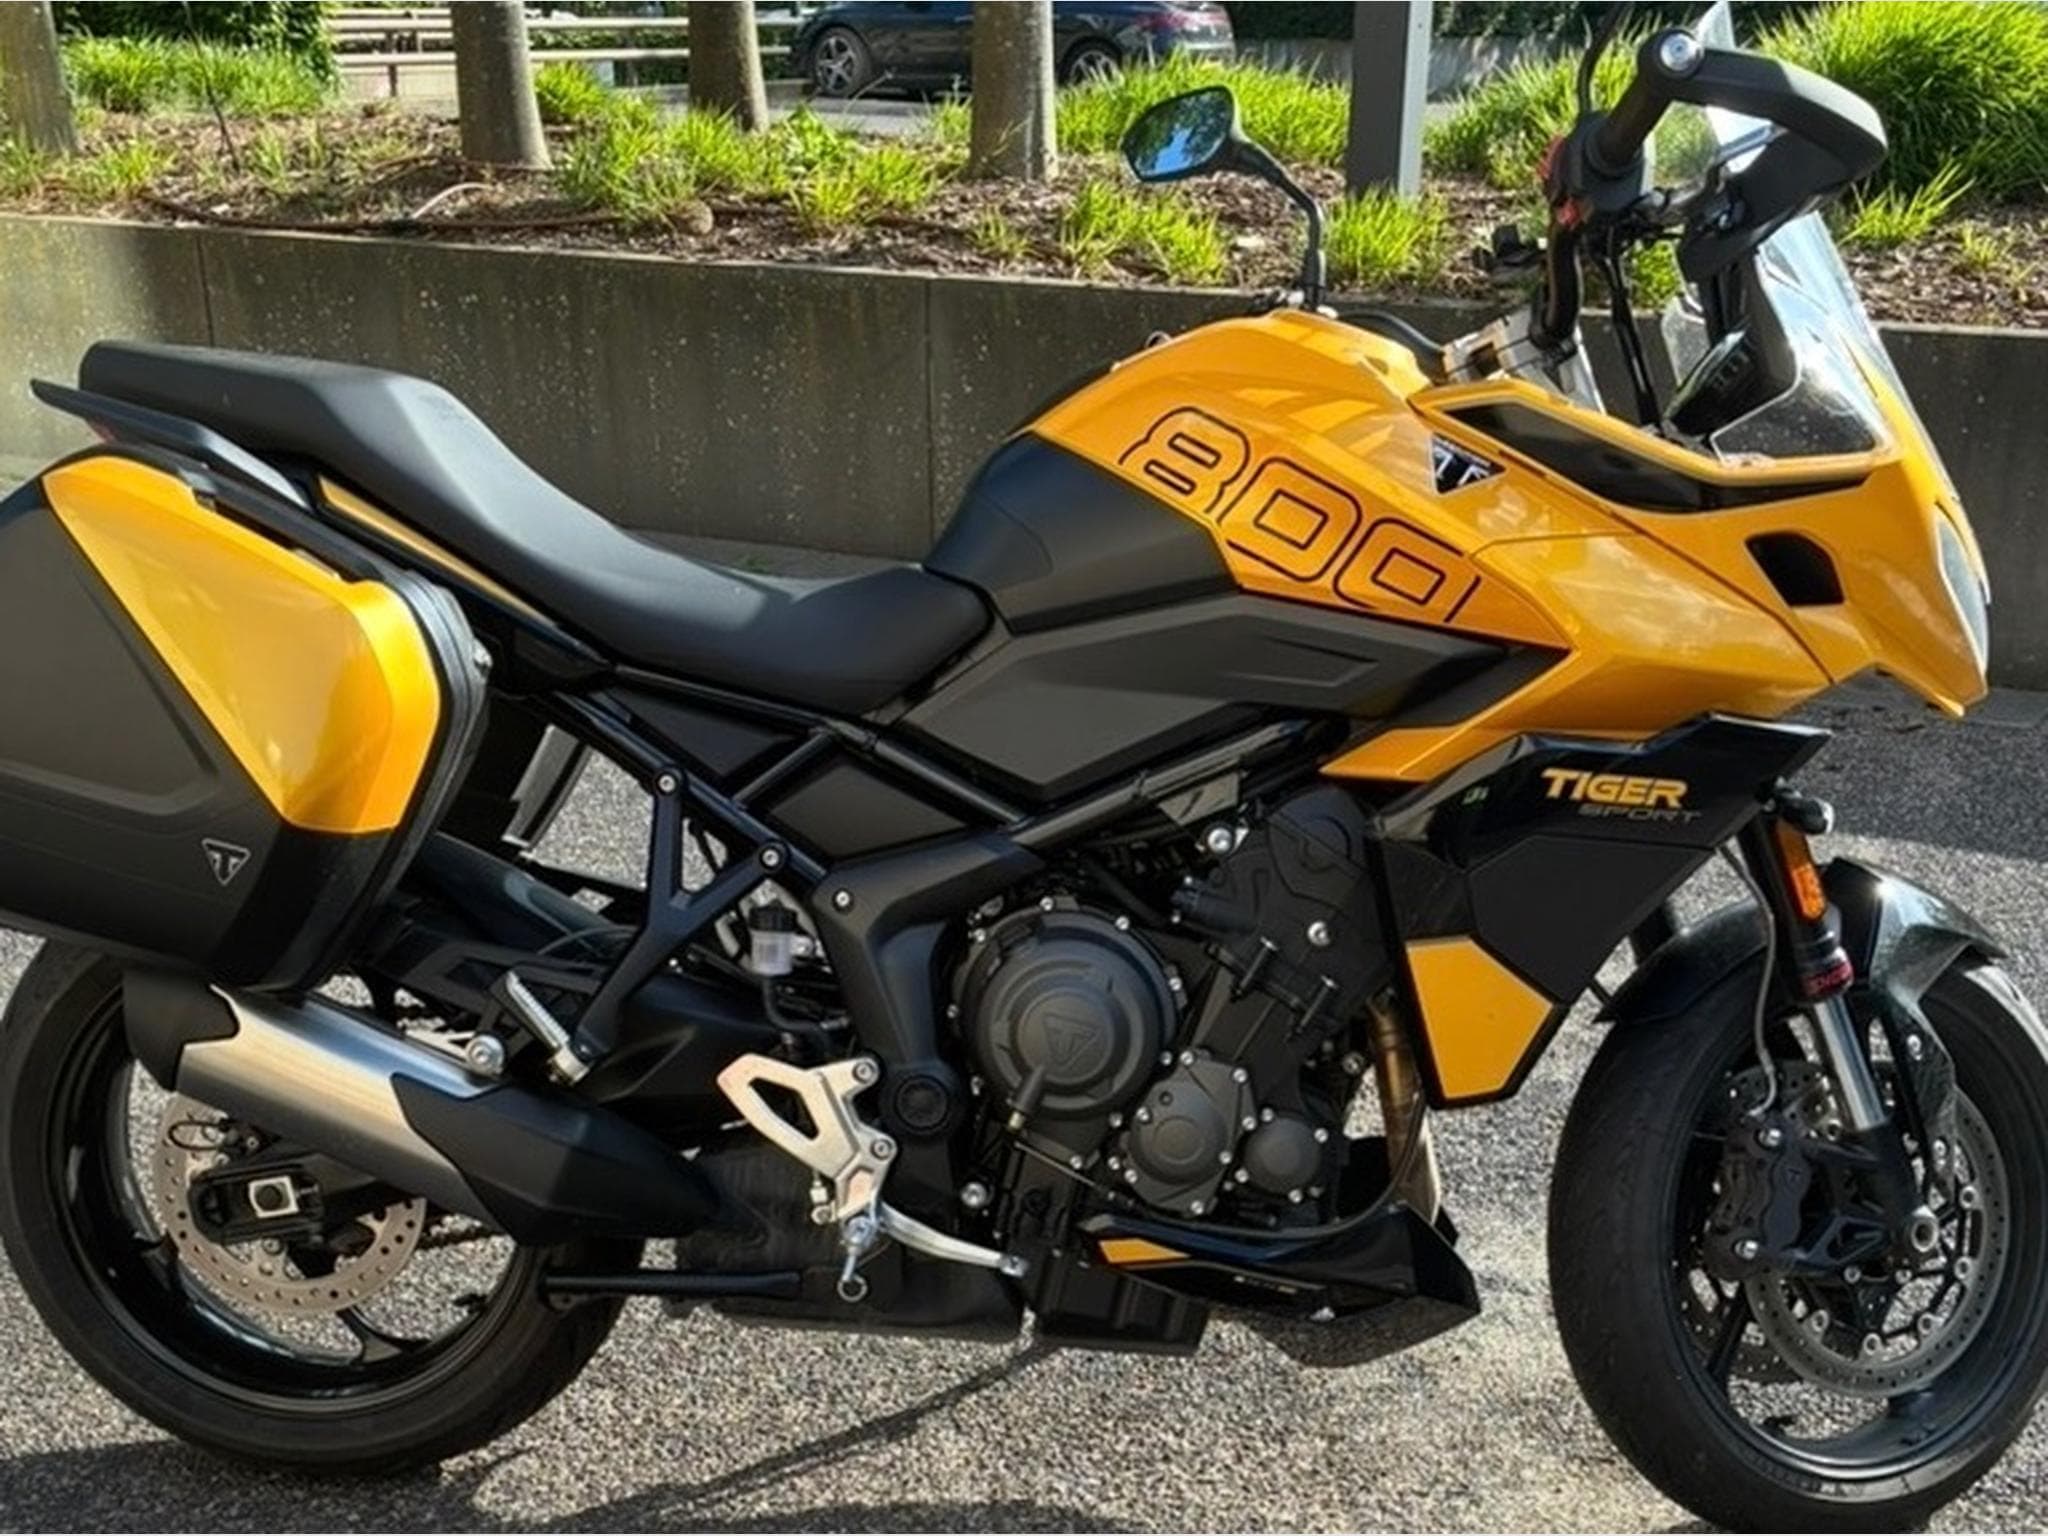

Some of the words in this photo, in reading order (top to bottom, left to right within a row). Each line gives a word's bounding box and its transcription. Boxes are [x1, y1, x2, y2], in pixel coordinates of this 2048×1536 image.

[1118, 406, 1482, 624] 800
[1541, 767, 1689, 808] TIGER
[1578, 803, 1702, 822] SPORT
